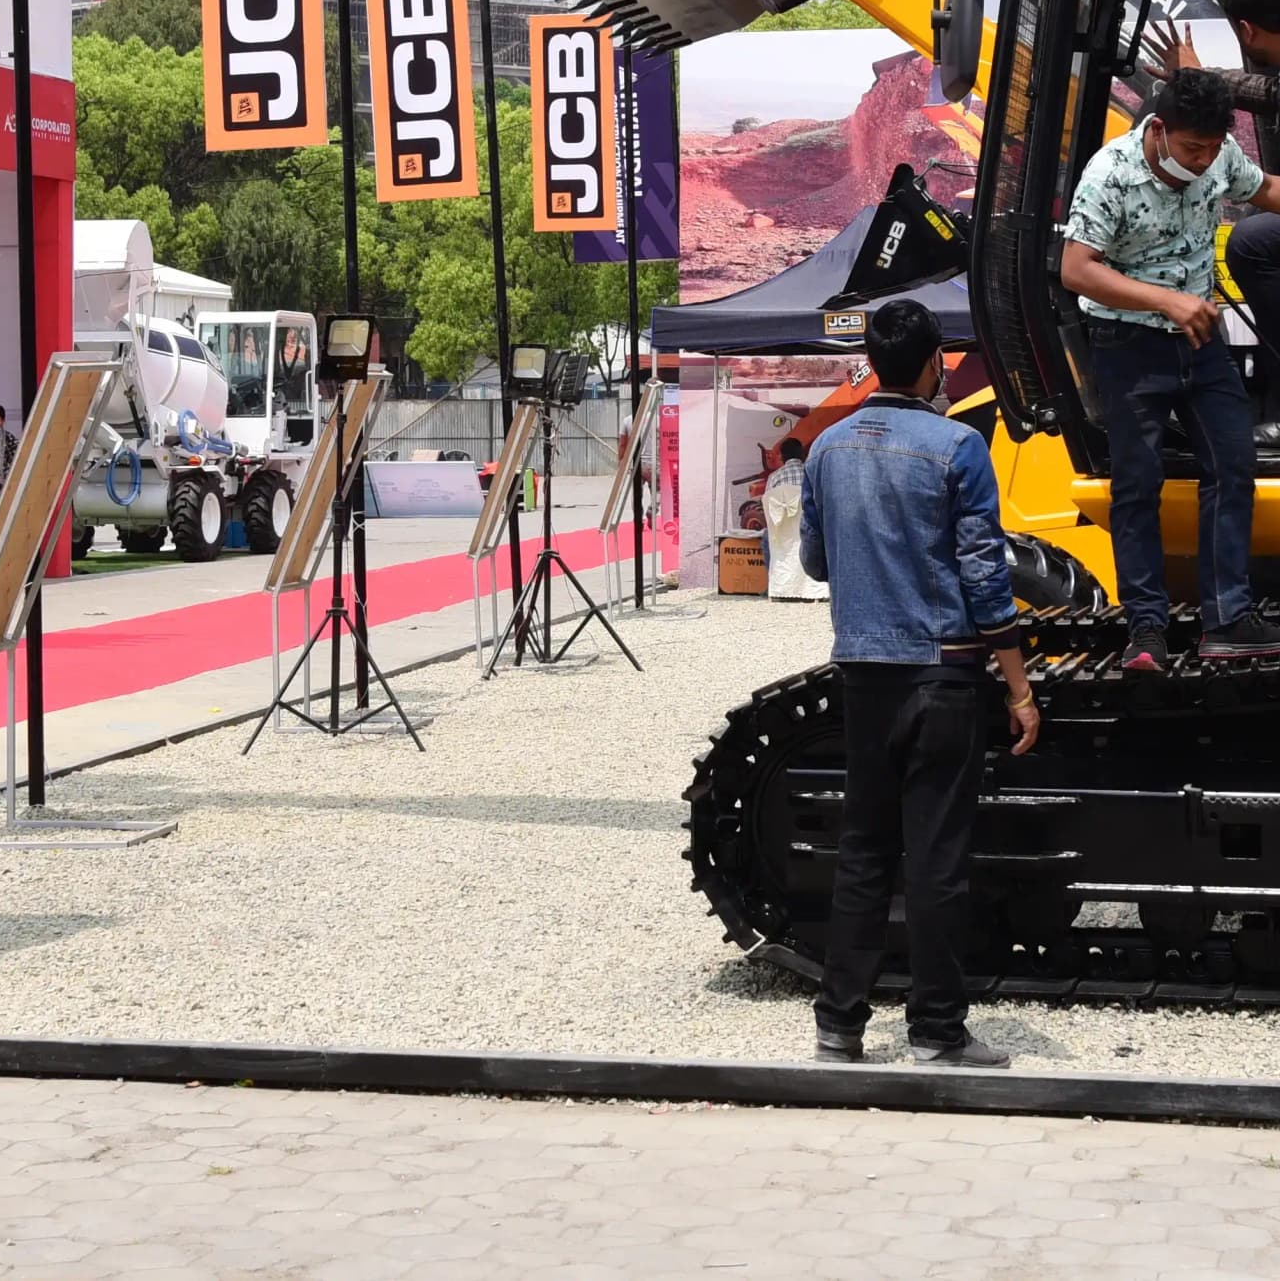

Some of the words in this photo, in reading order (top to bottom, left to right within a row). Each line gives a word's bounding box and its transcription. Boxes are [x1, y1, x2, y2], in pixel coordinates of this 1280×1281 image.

[548, 31, 598, 213] JCB
[880, 221, 906, 269] JCB
[828, 316, 862, 326] JCB
[850, 365, 871, 387] JCB
